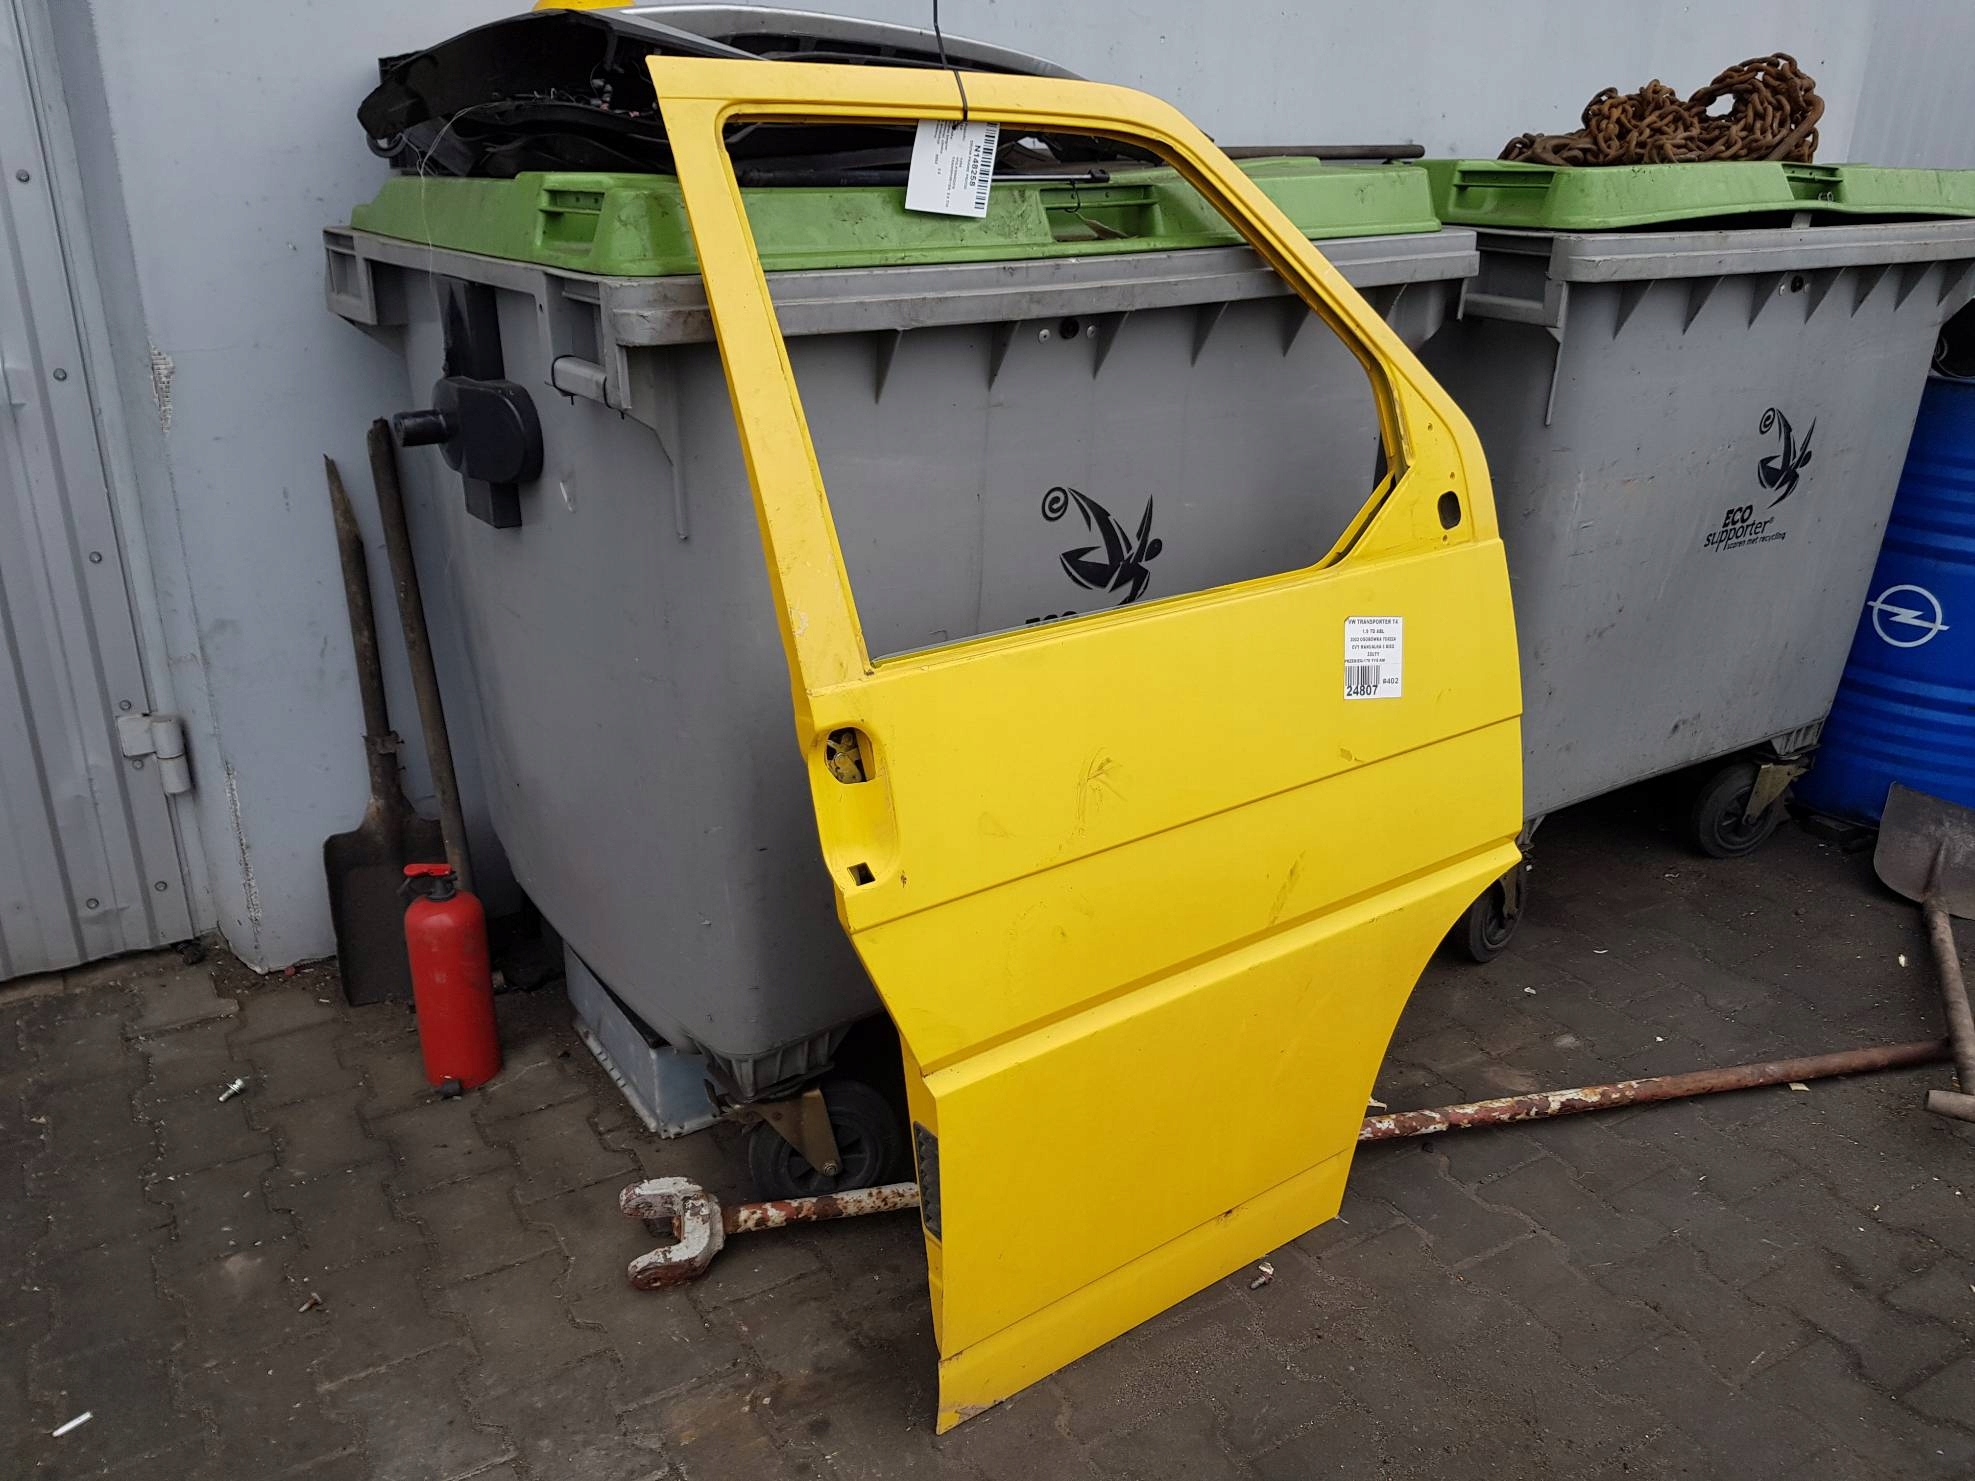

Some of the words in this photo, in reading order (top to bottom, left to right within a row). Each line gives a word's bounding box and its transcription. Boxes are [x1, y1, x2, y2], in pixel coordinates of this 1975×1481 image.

[969, 145, 981, 187] N148258
[1722, 504, 1754, 529] ECO
[1759, 532, 1786, 543] recycling
[1346, 684, 1378, 696] 24807
